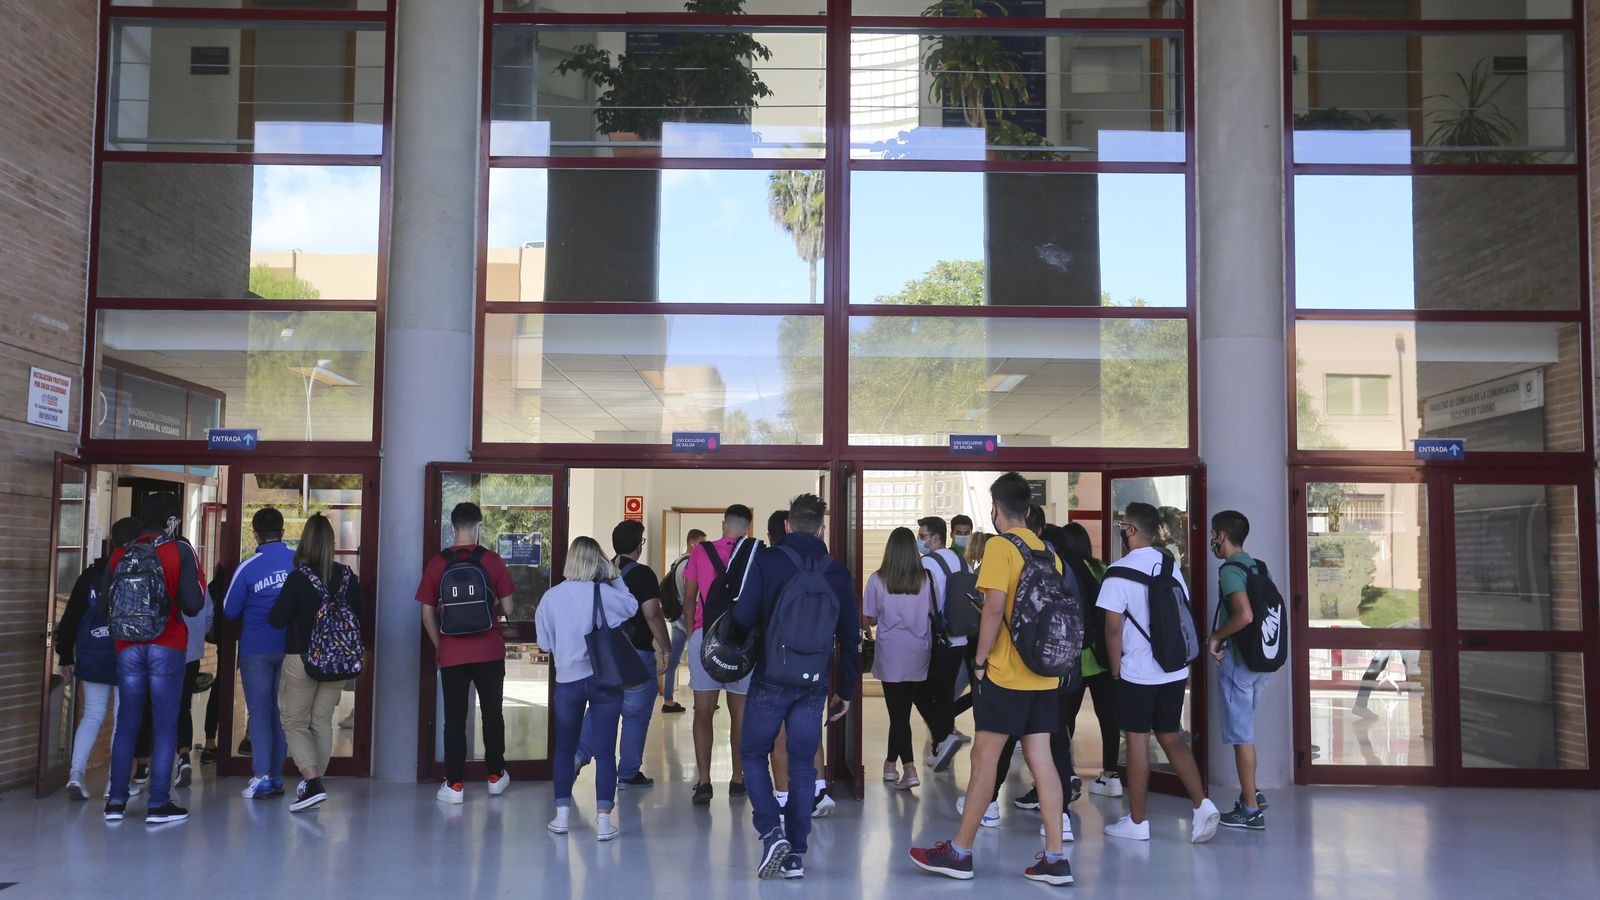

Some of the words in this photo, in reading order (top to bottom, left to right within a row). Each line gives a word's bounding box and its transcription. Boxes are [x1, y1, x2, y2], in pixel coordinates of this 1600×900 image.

[132, 418, 155, 431] ATENCIÓN
[161, 425, 180, 436] USUARIO
[212, 435, 241, 443] ENTRADA
[254, 572, 288, 593] MALAG
[712, 655, 739, 670] SCORPION
